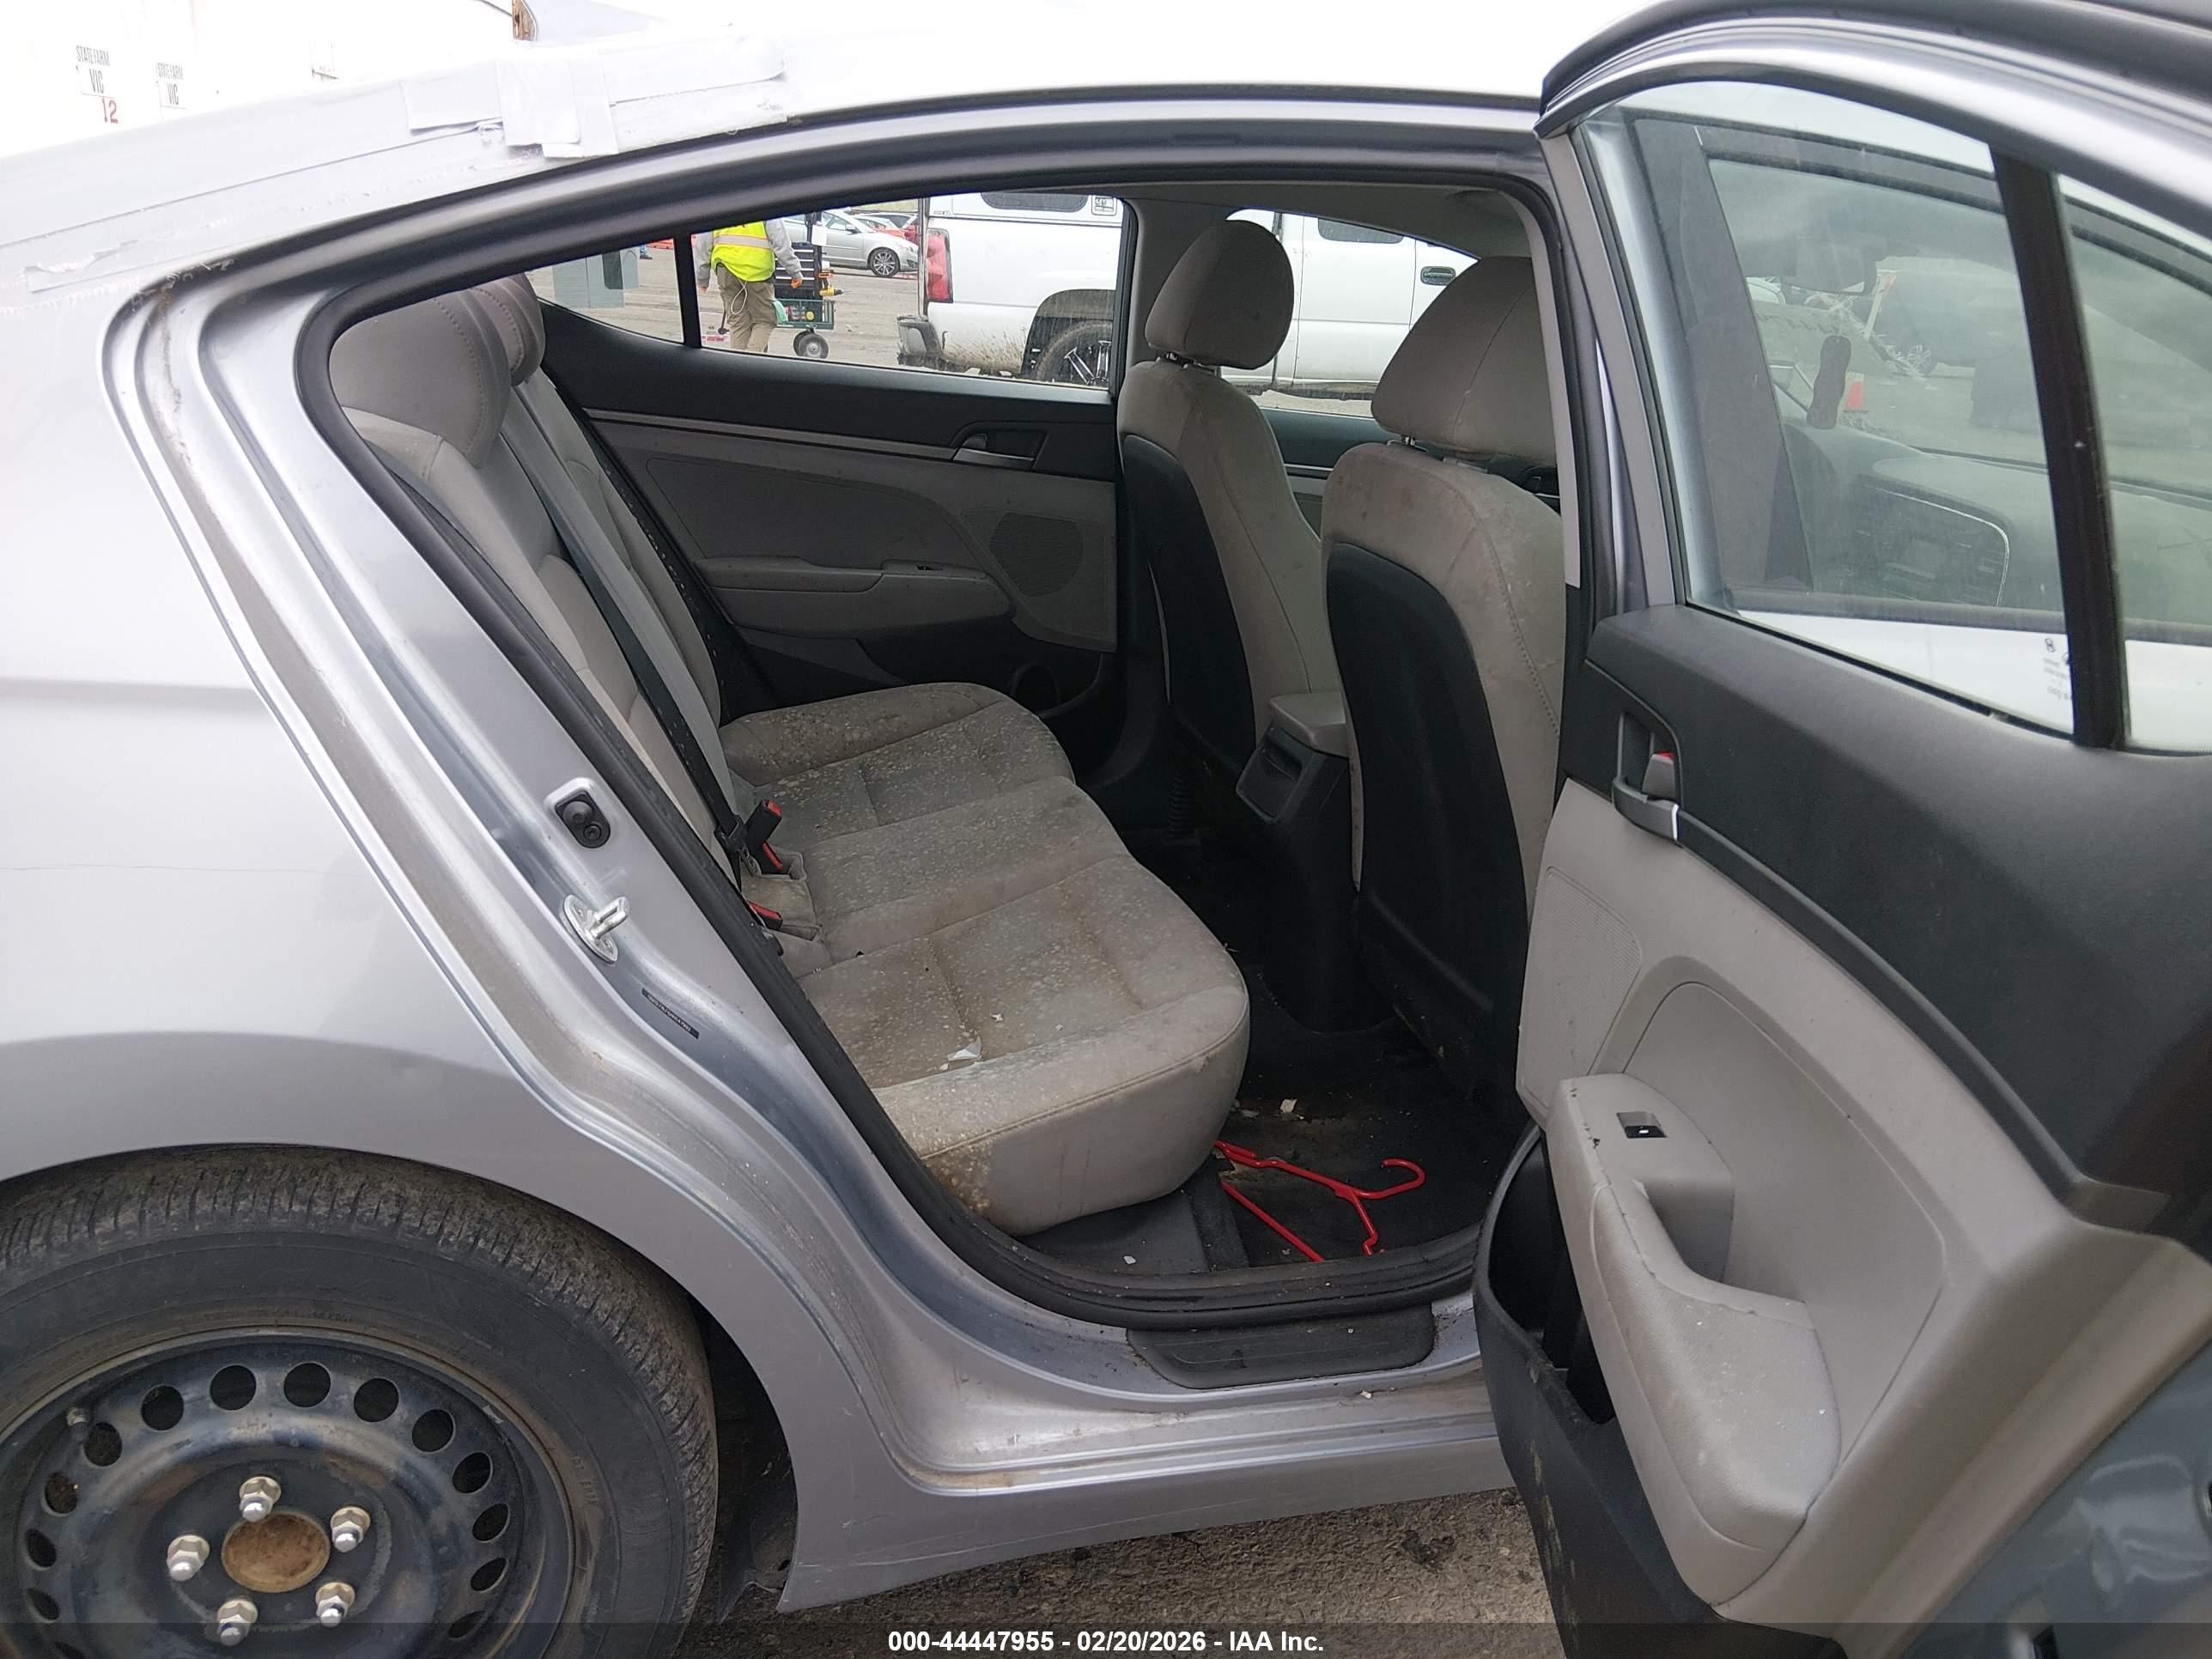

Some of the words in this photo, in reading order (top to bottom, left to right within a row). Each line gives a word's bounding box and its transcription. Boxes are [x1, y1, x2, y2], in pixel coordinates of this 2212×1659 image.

[76, 45, 94, 64] STATE
[94, 48, 110, 67] FARM
[88, 68, 105, 94] VIC
[167, 83, 179, 106] VIC
[101, 96, 118, 124] 12
